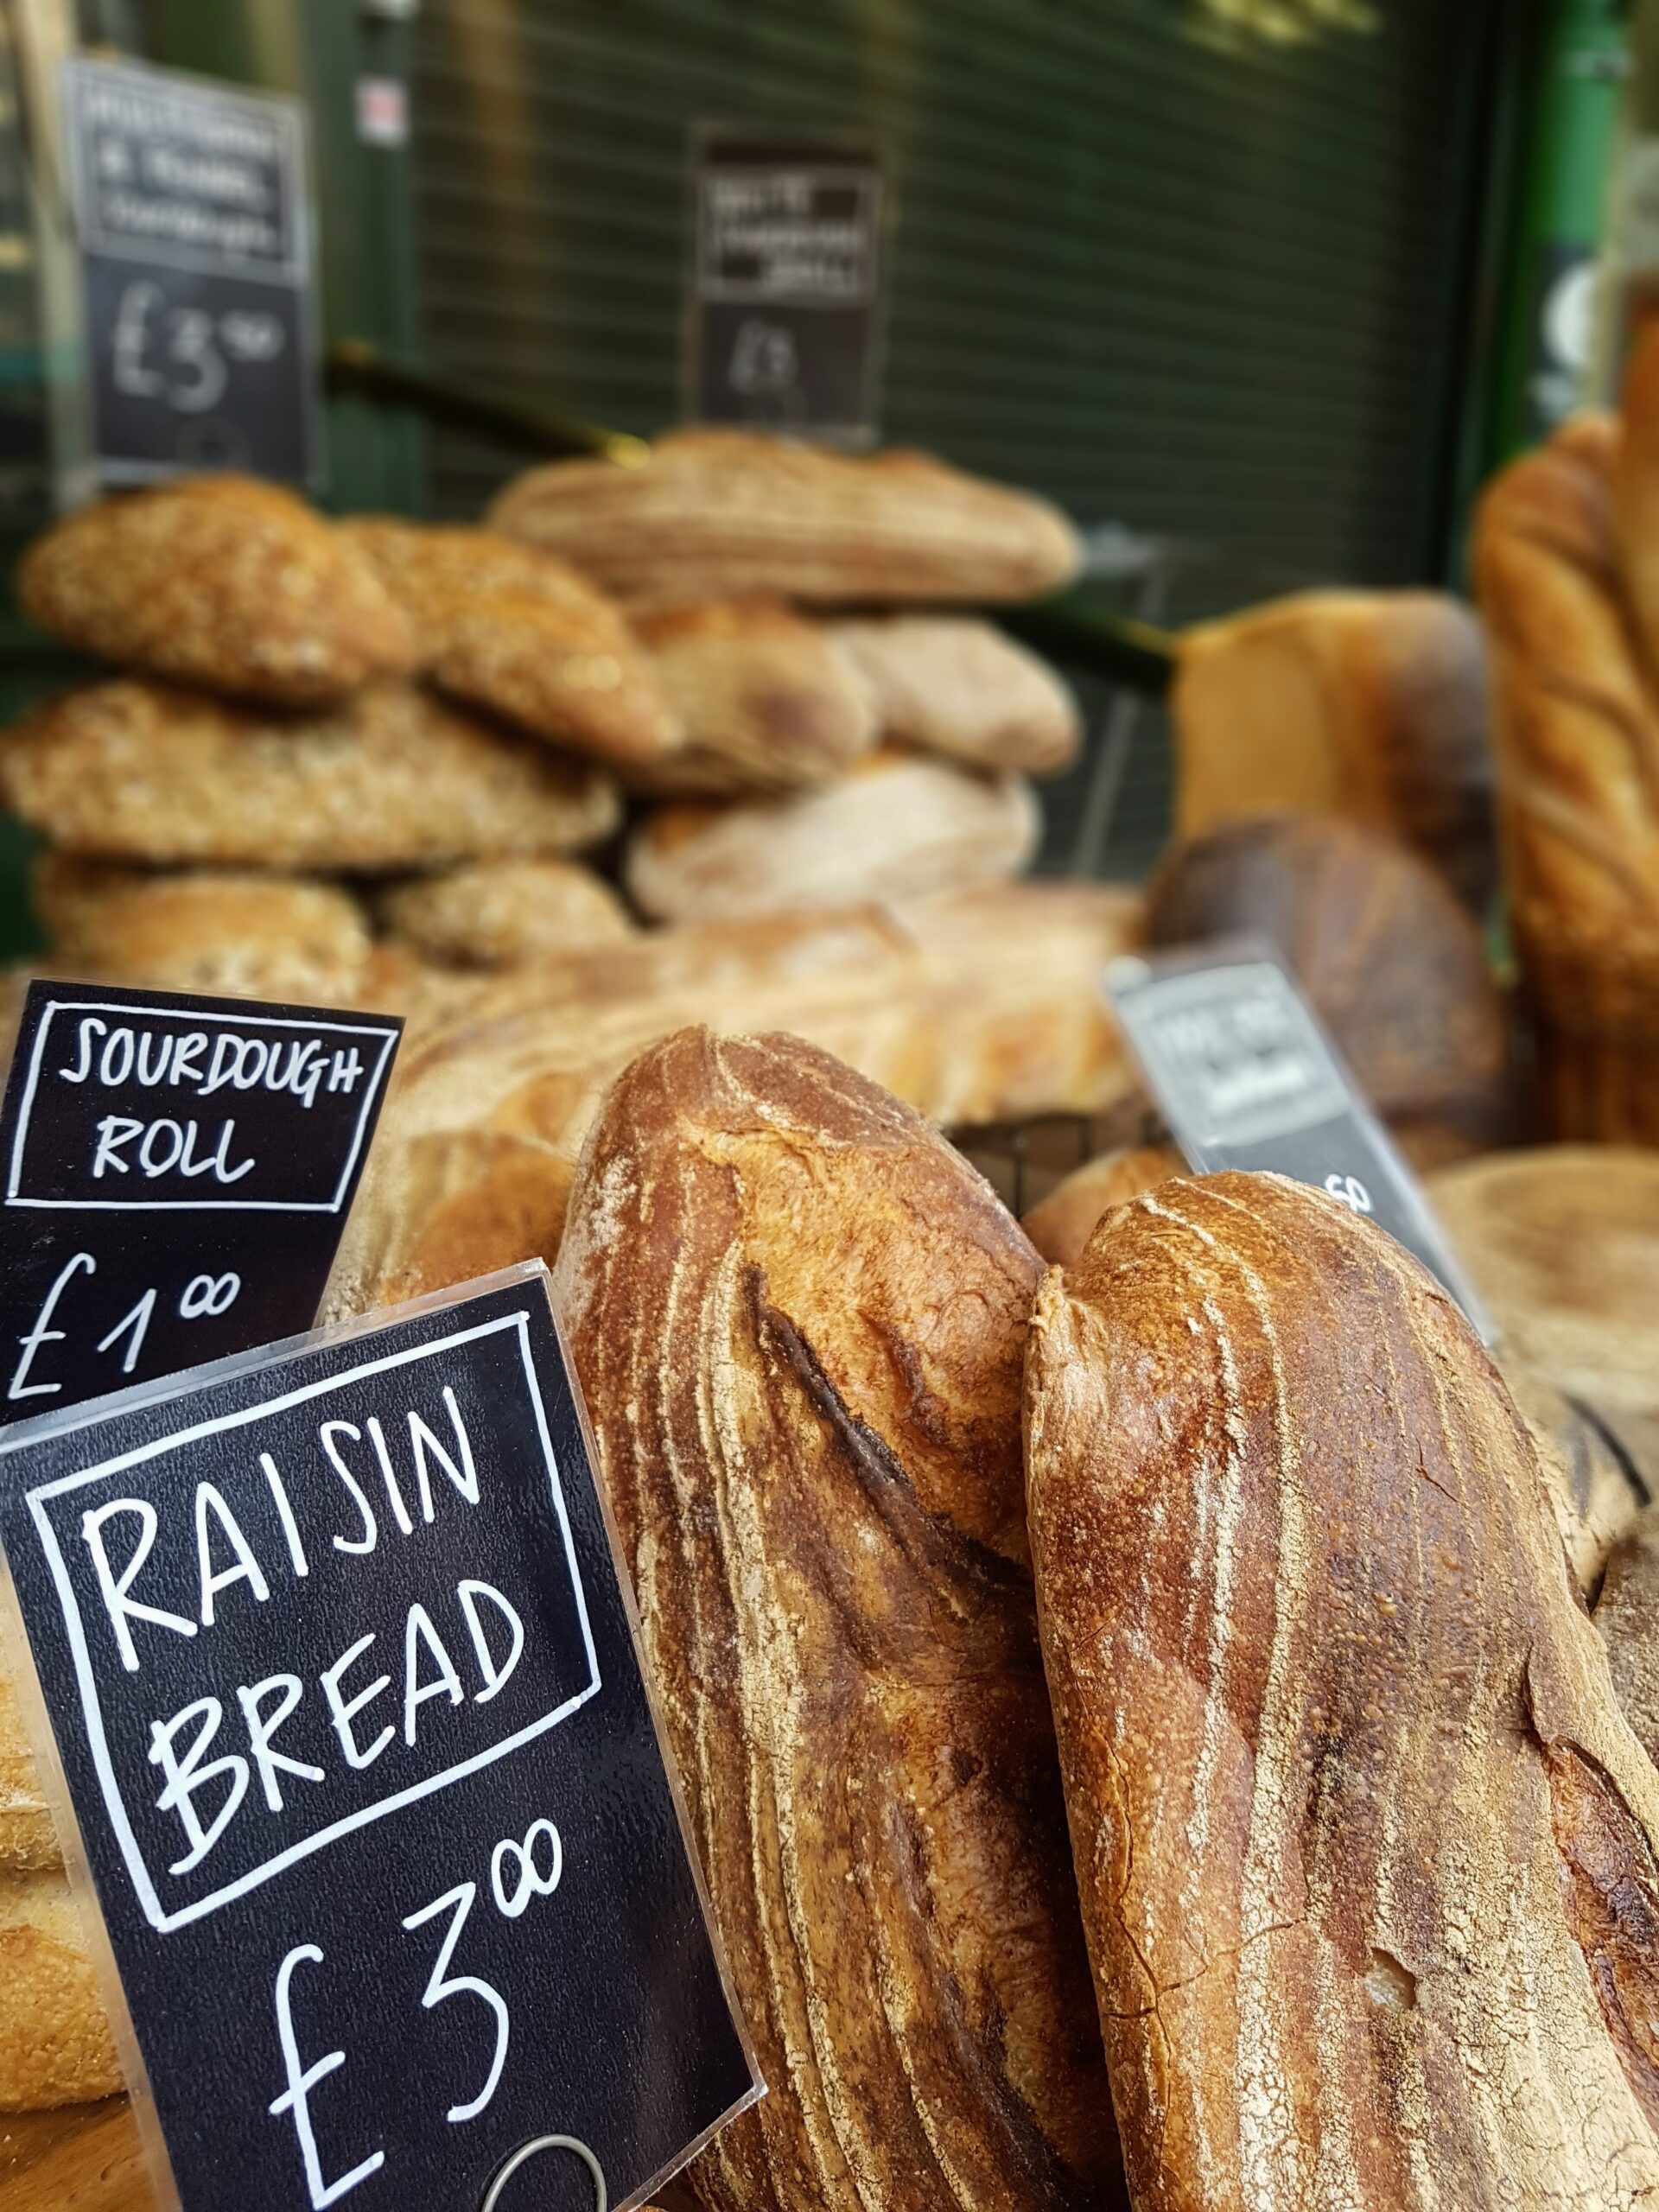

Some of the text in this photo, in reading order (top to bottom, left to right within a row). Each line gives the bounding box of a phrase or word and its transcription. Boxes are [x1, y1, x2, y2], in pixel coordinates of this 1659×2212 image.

[59, 1017, 364, 1109] SOURDOUGH
[92, 1115, 255, 1183] ROLL
[80, 1385, 481, 1673] RAISIN
[147, 1579, 525, 1876] BREAD
